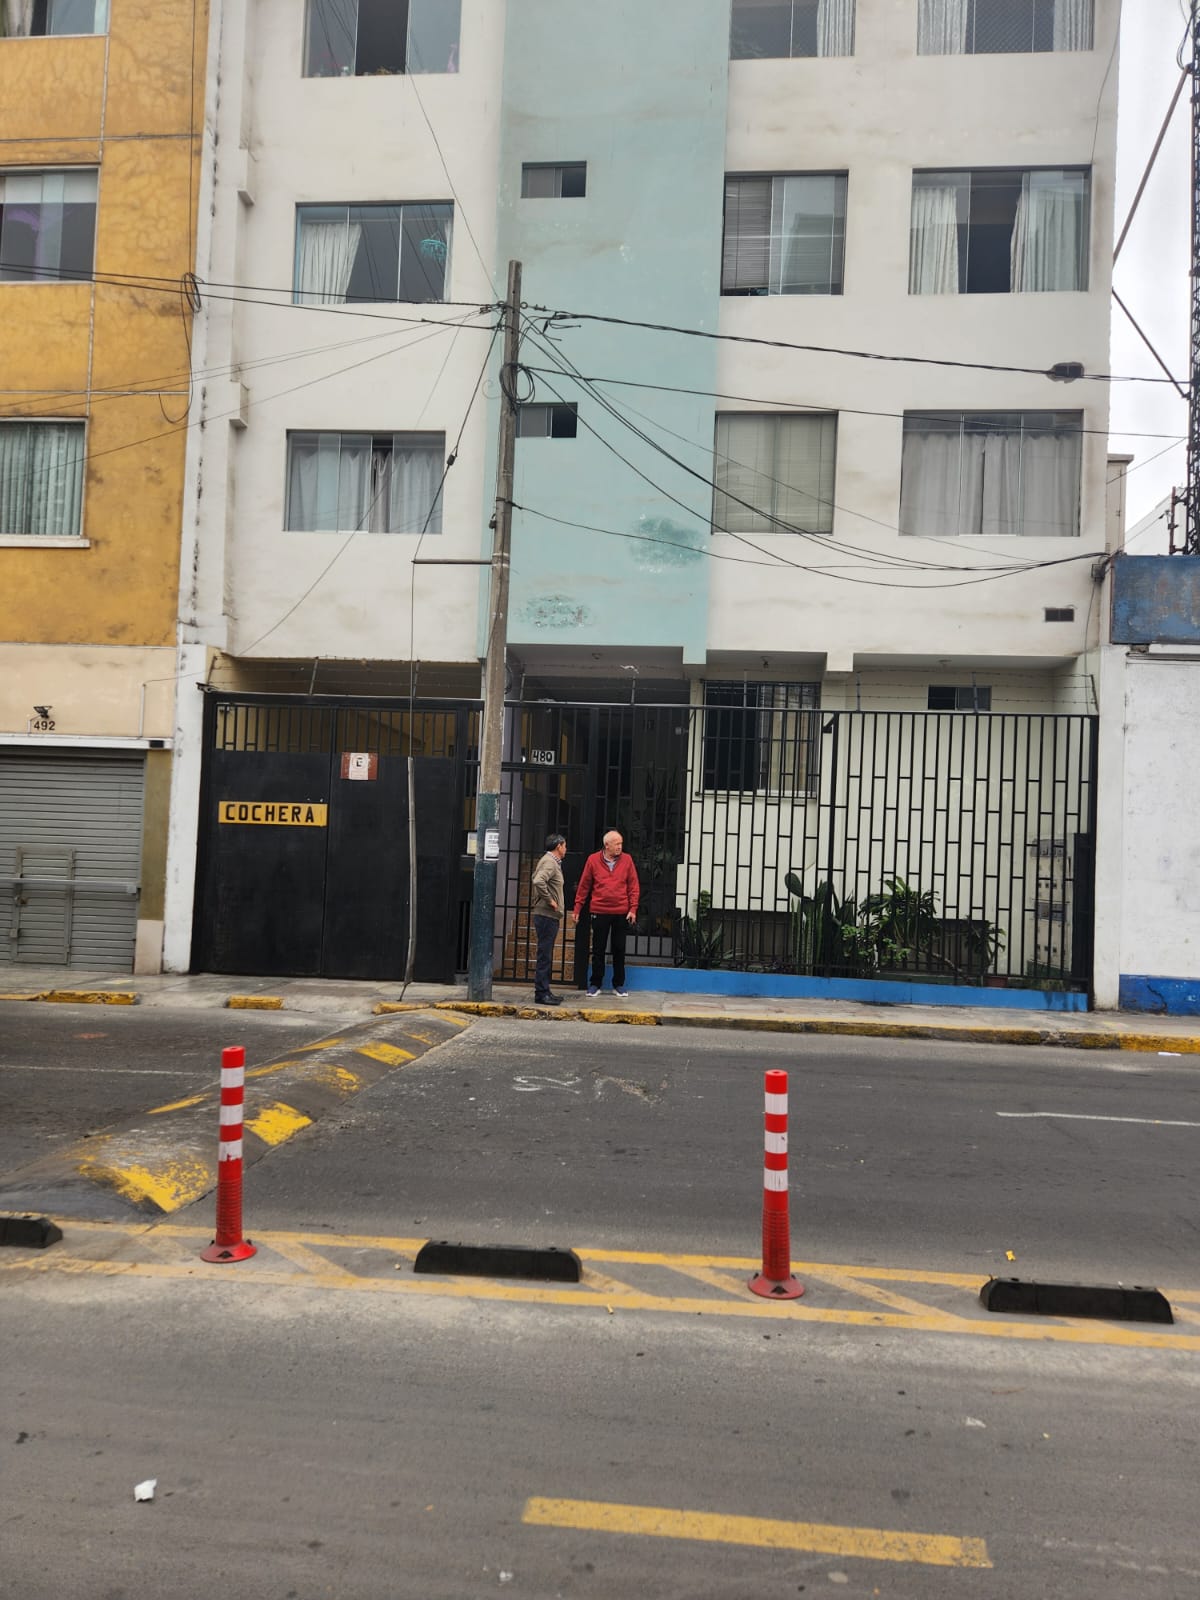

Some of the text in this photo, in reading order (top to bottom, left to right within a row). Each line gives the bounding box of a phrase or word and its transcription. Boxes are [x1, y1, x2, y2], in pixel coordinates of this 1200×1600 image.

[33, 720, 56, 731] 492
[533, 750, 553, 763] 480
[226, 804, 315, 823] COCHERA
